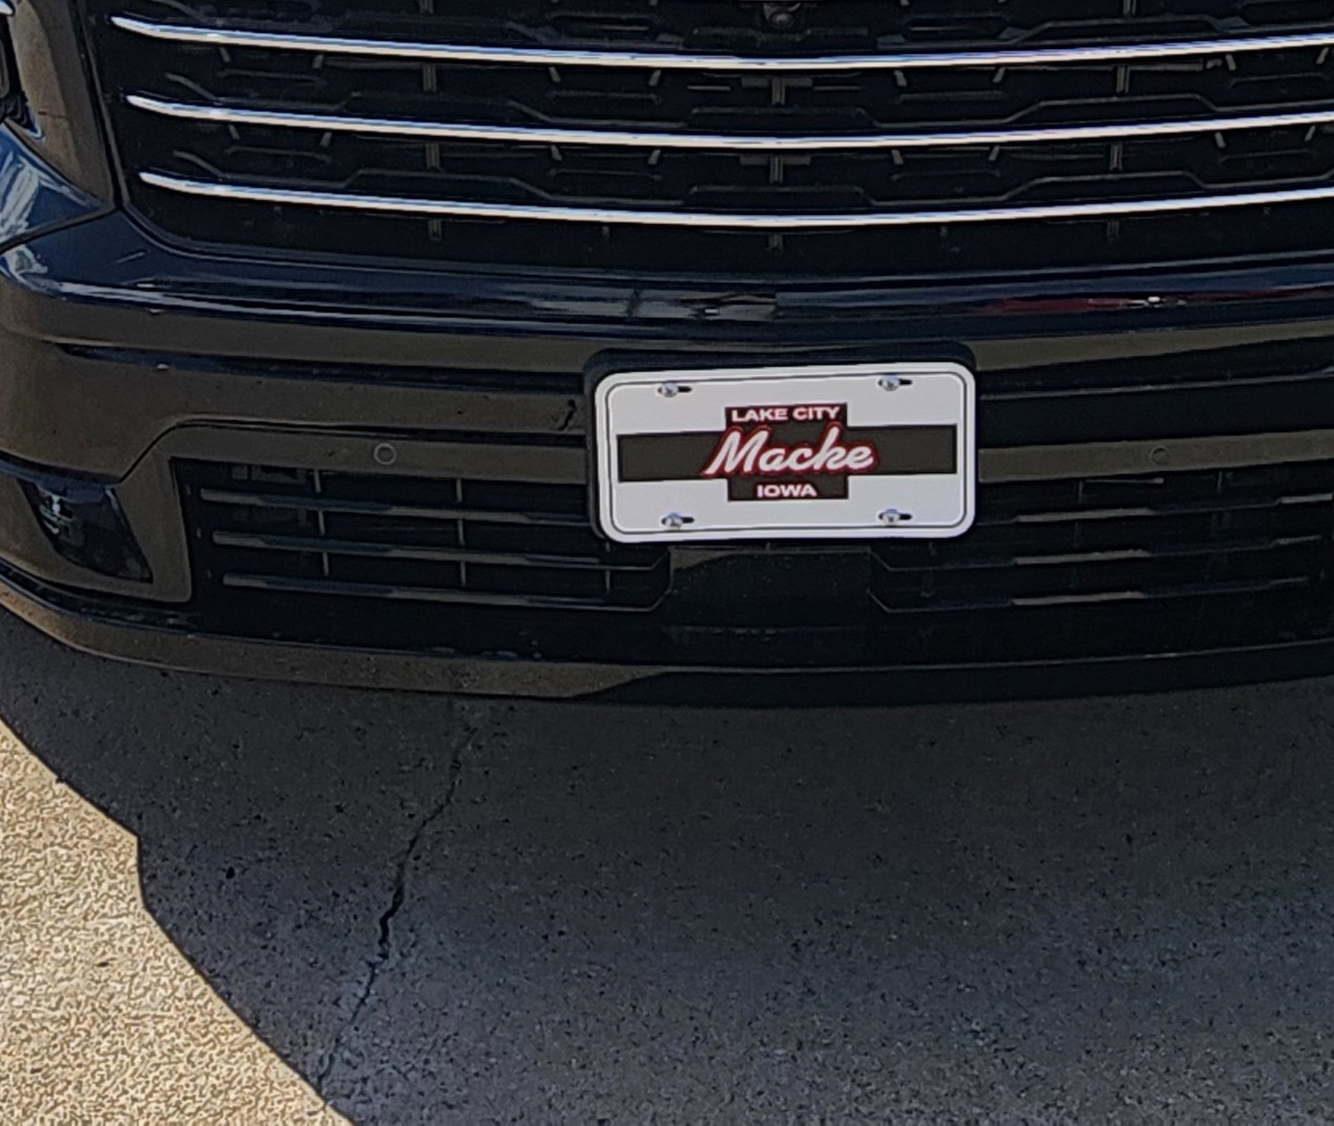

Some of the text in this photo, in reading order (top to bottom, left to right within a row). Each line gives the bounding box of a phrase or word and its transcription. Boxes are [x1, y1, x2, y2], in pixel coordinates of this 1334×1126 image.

[731, 406, 840, 422] LAKE CITY
[703, 426, 876, 476] Macke
[756, 483, 818, 498] IOWA
